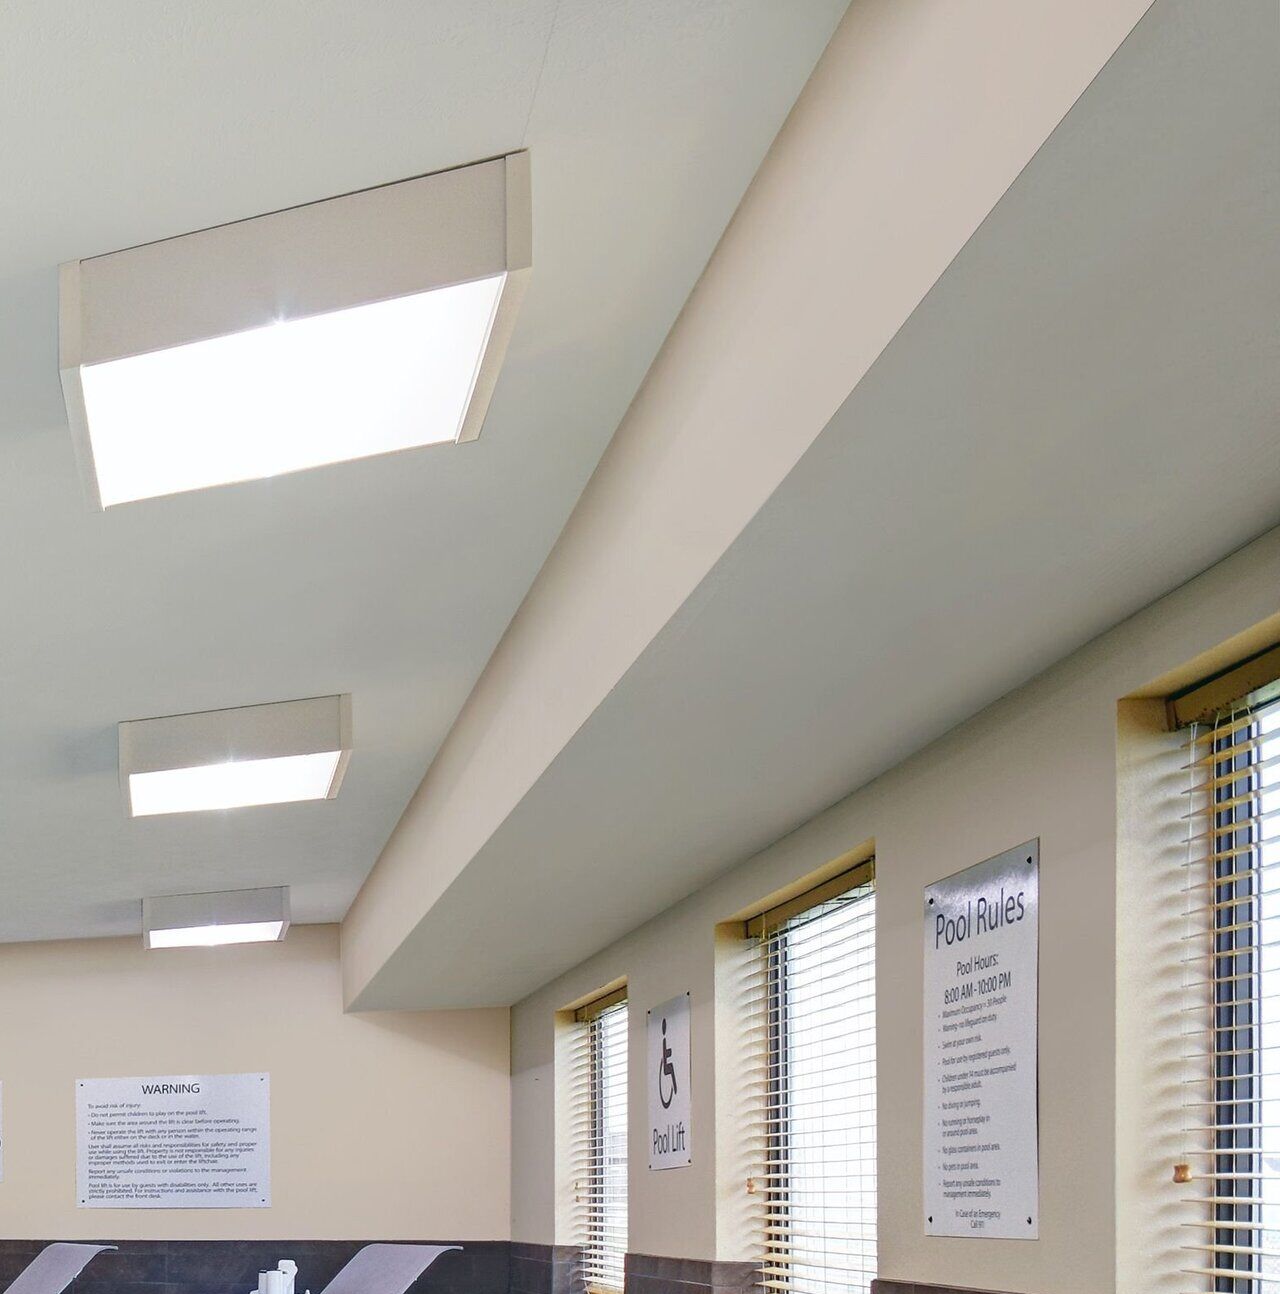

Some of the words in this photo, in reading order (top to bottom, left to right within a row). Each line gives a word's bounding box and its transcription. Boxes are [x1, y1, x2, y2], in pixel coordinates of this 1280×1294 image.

[936, 901, 971, 949] Pool
[977, 888, 1024, 936] Rules
[957, 957, 973, 977] Pool
[974, 953, 999, 972] Hours:
[944, 986, 960, 1004] 8:00
[961, 982, 974, 999] AM
[978, 976, 998, 997] 10:00
[999, 971, 1012, 988] PM
[141, 1083, 200, 1095] WARNING
[653, 1125, 670, 1155] Pool
[672, 1121, 686, 1152] Lift
